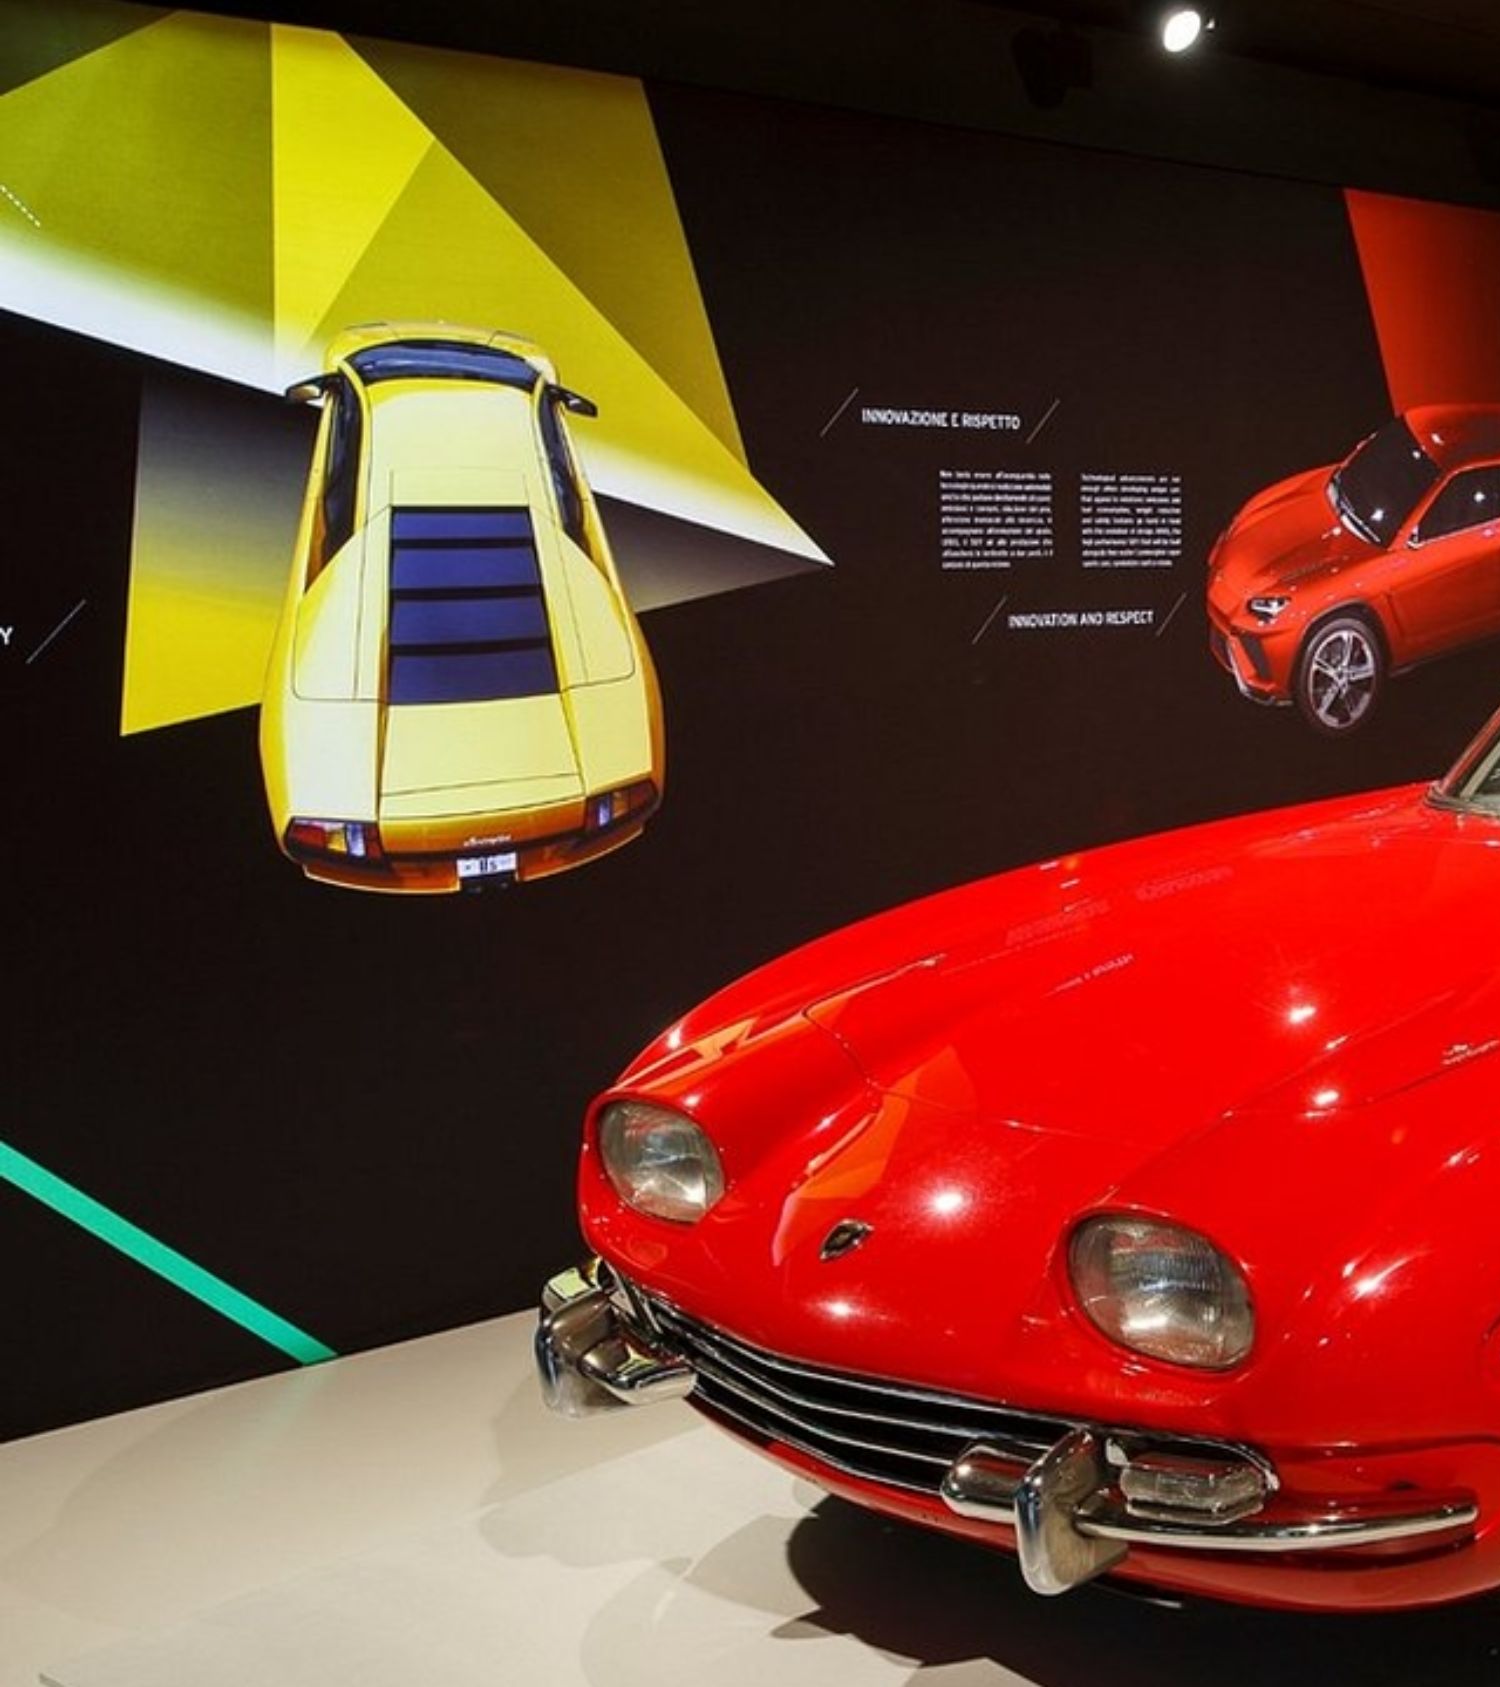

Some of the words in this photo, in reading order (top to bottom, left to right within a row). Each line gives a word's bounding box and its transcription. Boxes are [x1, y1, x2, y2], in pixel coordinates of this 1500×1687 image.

[861, 408, 948, 428] INNOVAZIONE
[950, 411, 960, 428] E
[962, 413, 1021, 430] RISPETTO
[1008, 612, 1078, 629] INNOVATION
[1080, 611, 1104, 626] AND
[1105, 609, 1154, 625] RESPECT
